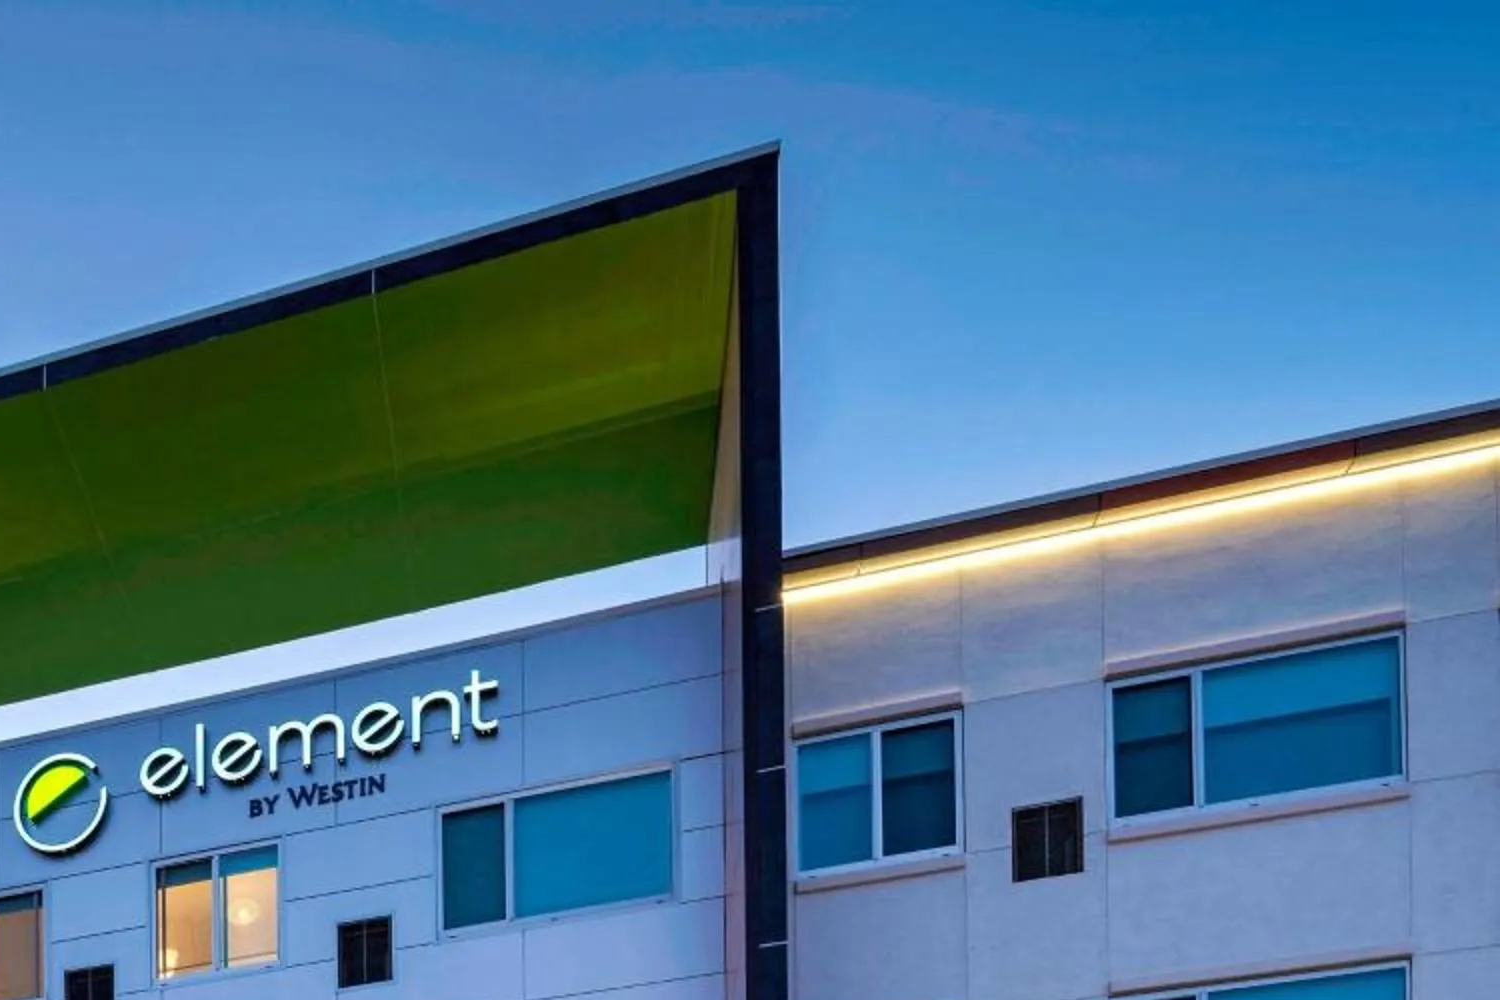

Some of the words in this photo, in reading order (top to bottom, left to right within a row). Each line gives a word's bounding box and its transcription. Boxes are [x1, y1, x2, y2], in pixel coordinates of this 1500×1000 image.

[140, 670, 499, 796] element
[249, 794, 281, 818] BY
[286, 773, 386, 810] WESTIN
